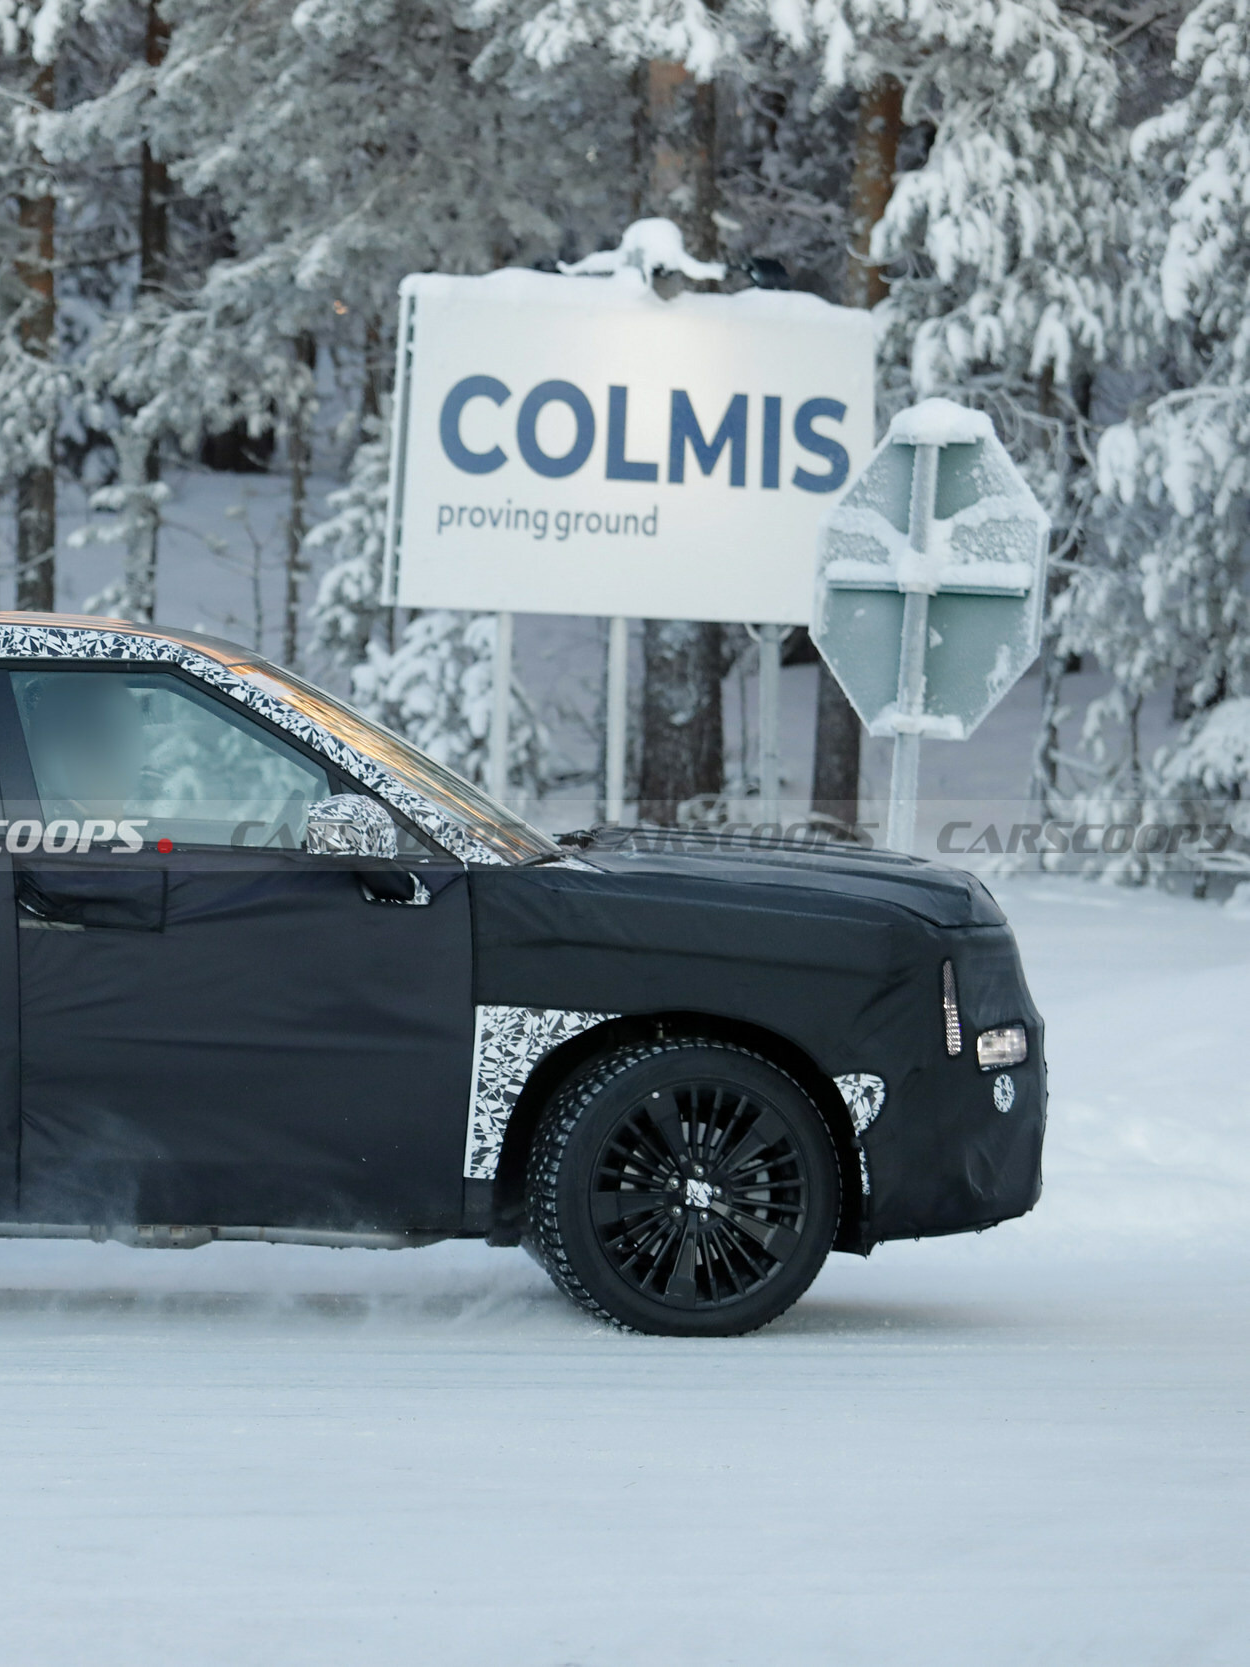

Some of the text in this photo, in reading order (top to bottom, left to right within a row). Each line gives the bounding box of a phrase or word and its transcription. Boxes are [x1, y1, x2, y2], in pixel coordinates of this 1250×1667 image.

[439, 374, 851, 494] COLMIS
[437, 498, 658, 541] proving ground
